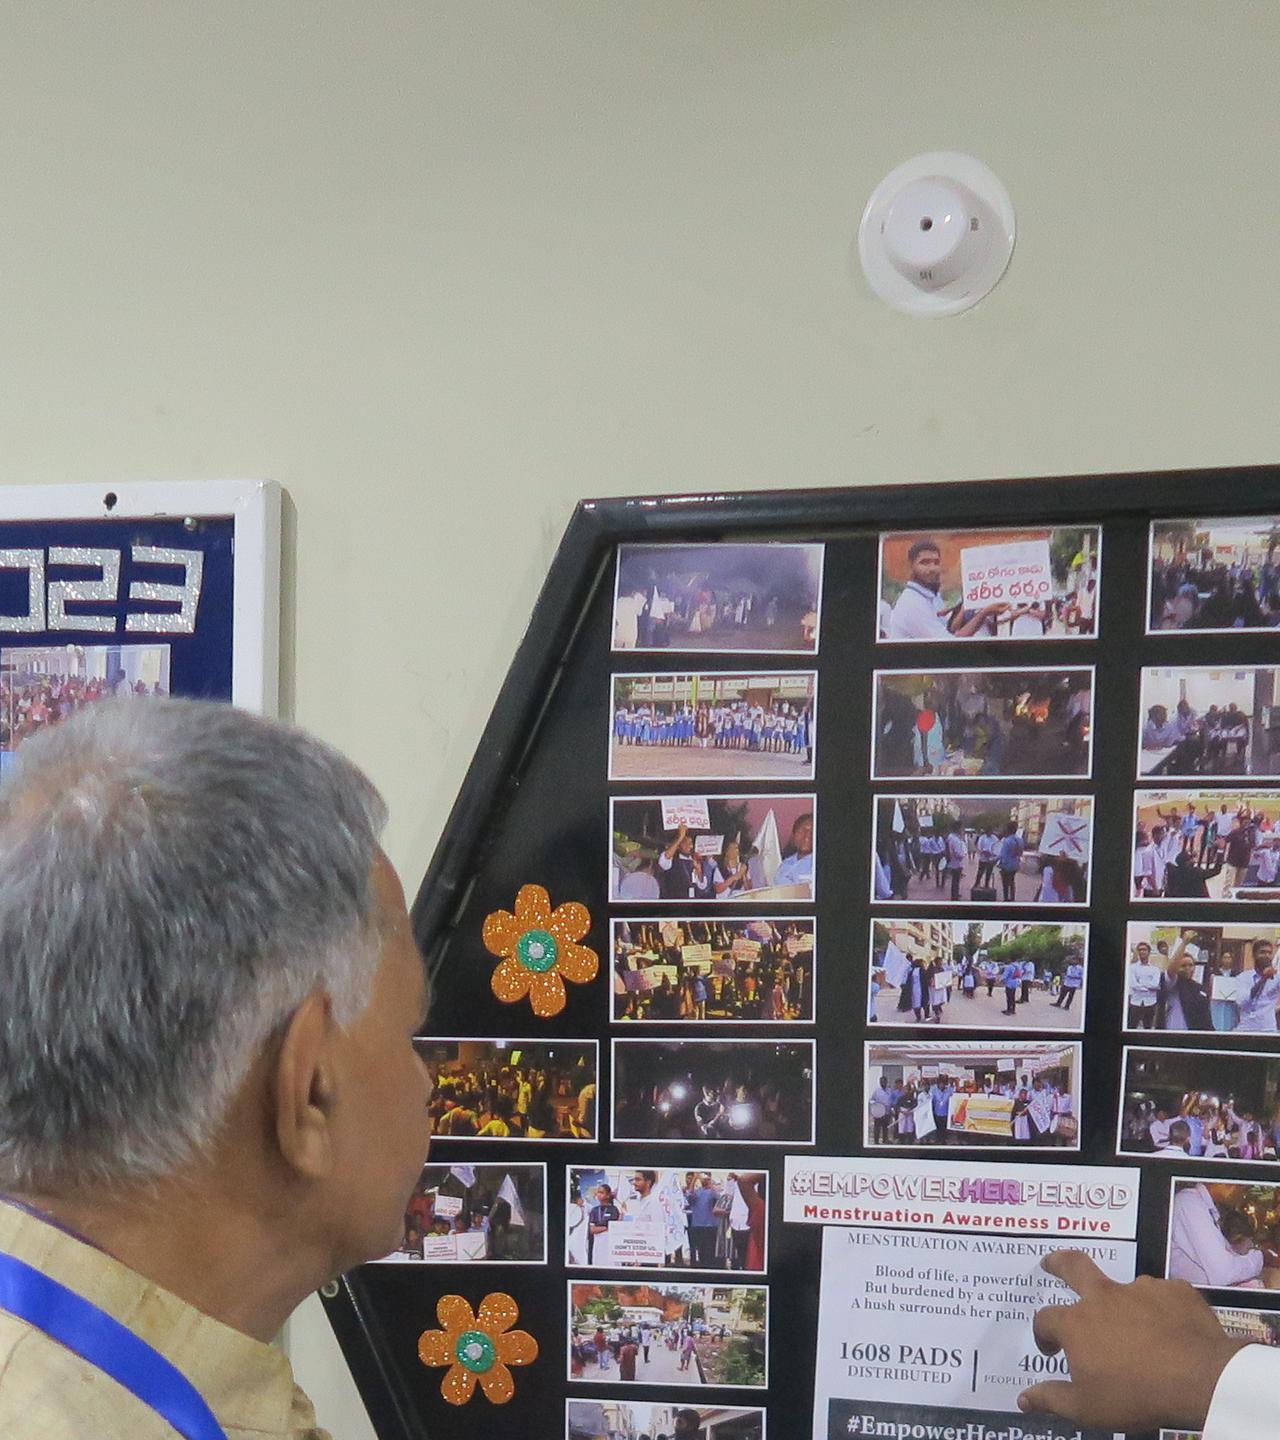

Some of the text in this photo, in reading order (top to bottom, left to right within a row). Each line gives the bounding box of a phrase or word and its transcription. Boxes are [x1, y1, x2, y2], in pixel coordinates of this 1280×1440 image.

[791, 1169, 1133, 1210] #EMPOWERHERPERIOD
[803, 1205, 1111, 1233] Menstruation Awareness Drive
[847, 1231, 969, 1252] MENSTRUATION
[875, 1264, 1072, 1289] Blood of life, a powerful strea
[865, 1281, 887, 1294] But
[891, 1282, 954, 1299] burdened
[958, 1286, 974, 1304] by
[977, 1291, 984, 1301] a
[988, 1288, 1044, 1306] culture's
[851, 1297, 861, 1309] A
[864, 1298, 895, 1312] hush
[899, 1301, 966, 1317] surrounds
[970, 1305, 991, 1319] her
[995, 1308, 1029, 1323] pain,
[840, 1341, 963, 1369] 1608 PADS
[848, 1365, 952, 1384] DISTRIBUTED
